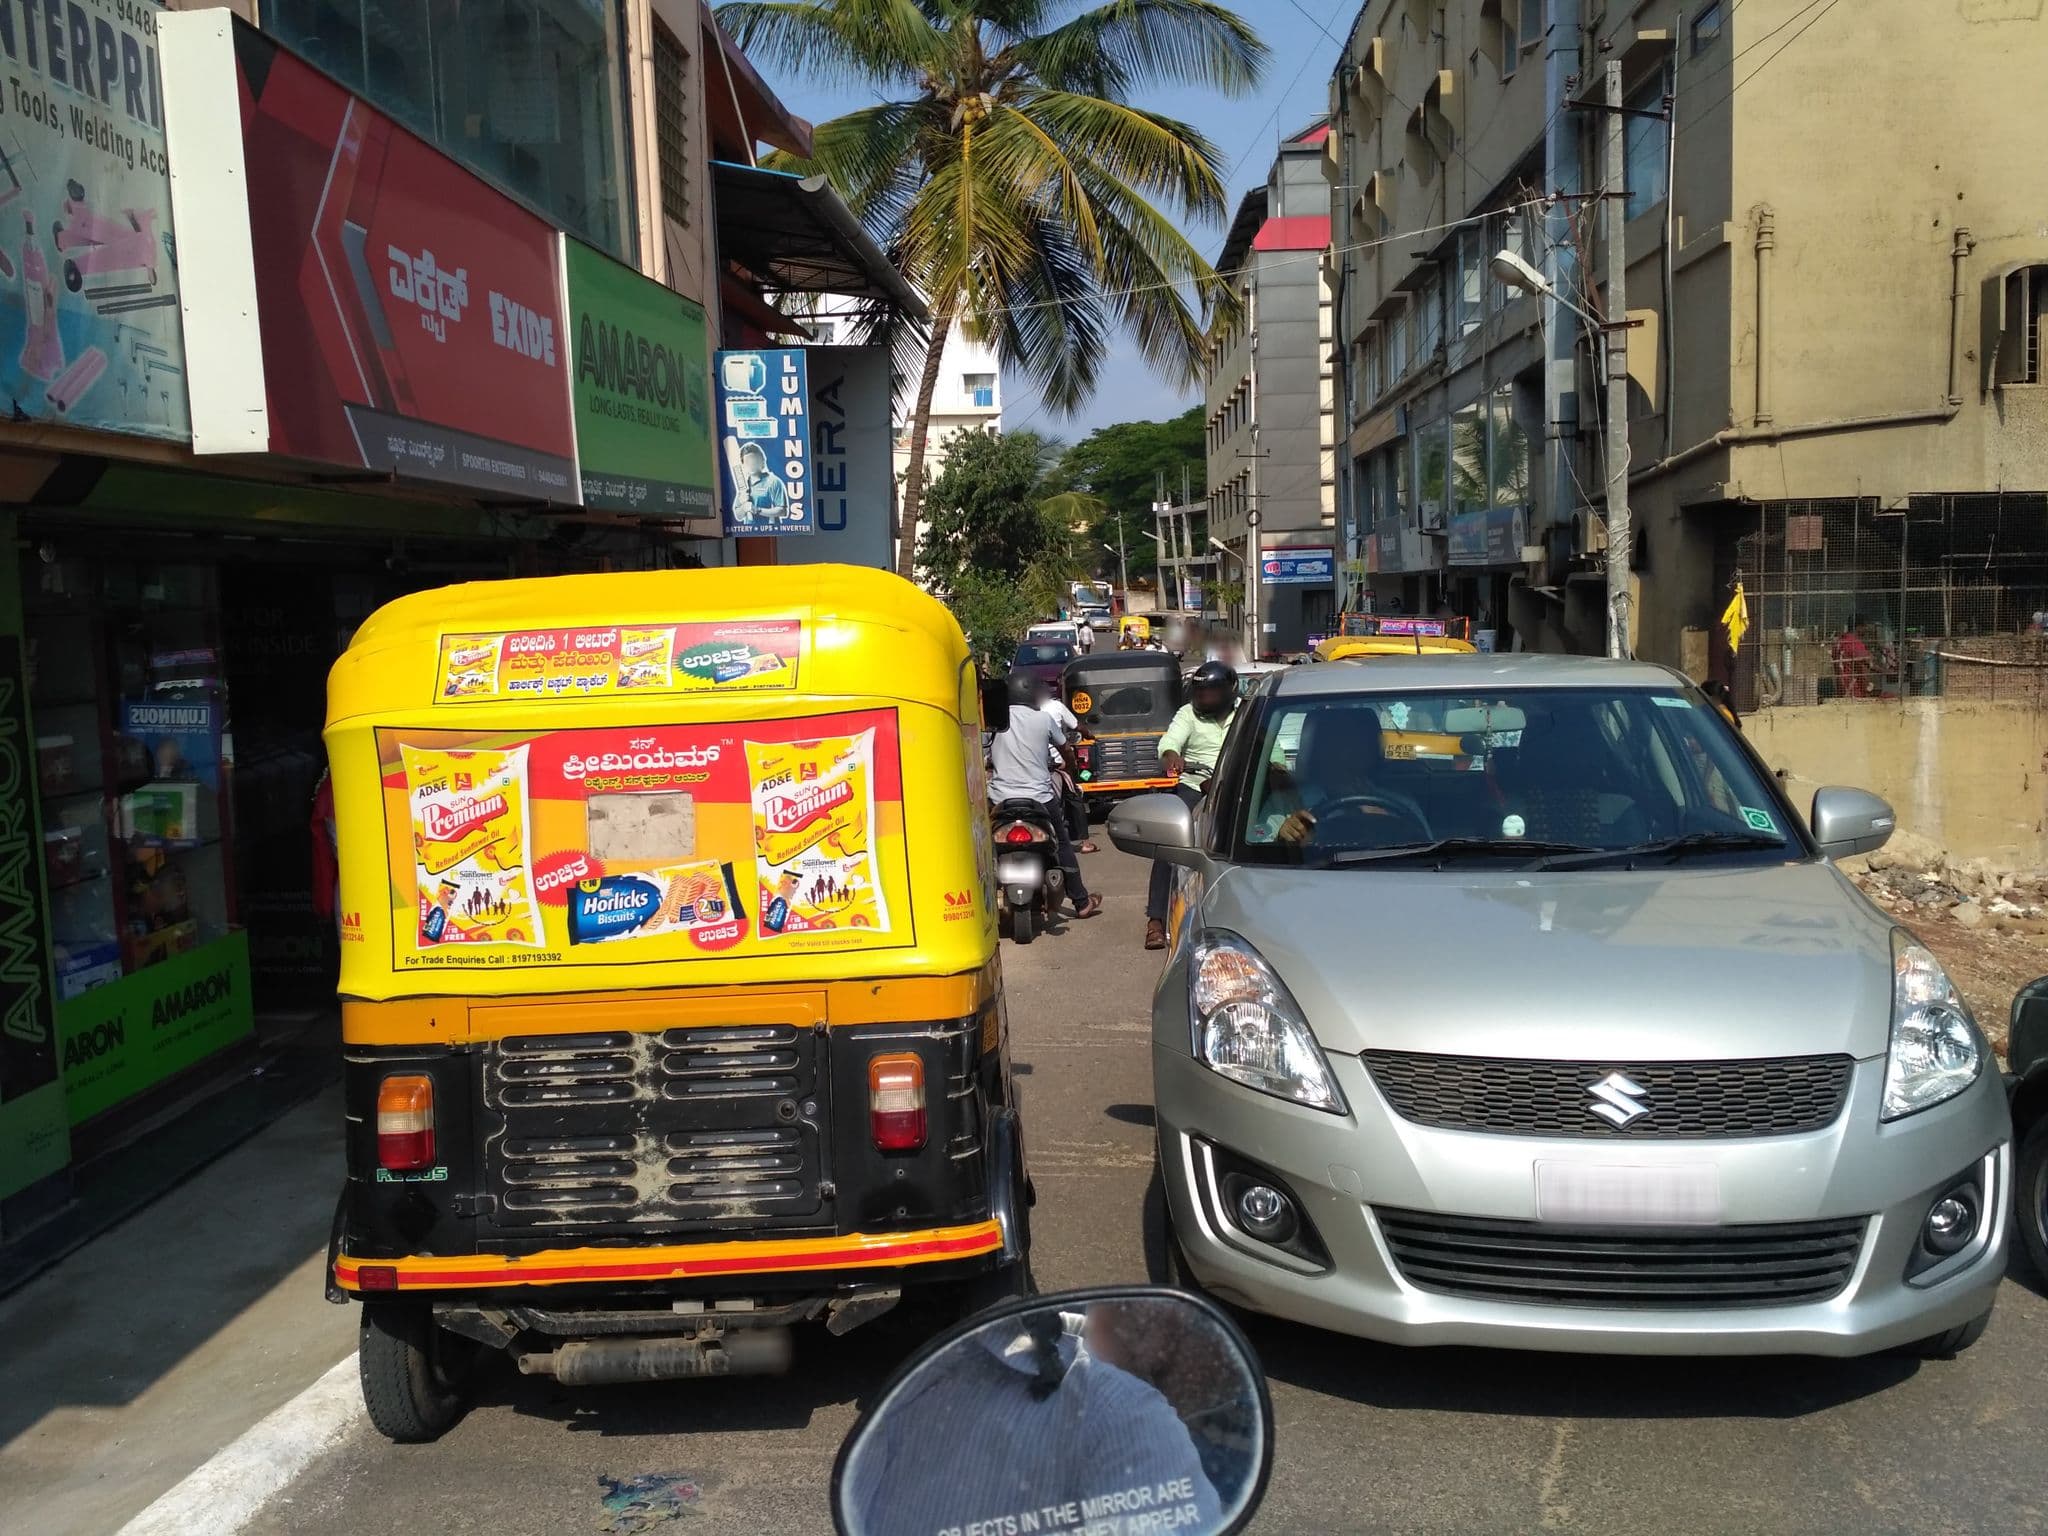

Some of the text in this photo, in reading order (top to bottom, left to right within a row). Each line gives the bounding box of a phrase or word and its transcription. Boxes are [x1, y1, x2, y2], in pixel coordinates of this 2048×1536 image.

[10, 76, 169, 178] Tools, Welding Acc
[488, 290, 556, 367] EXIDE
[579, 312, 686, 413] AMARON
[780, 354, 805, 521] LUMINOUS
[815, 375, 847, 531] CERA
[760, 524, 773, 533] UPS
[780, 524, 811, 533] INVERTER
[682, 645, 752, 669] ಉಚಿತ
[562, 745, 721, 780] ಪ್ರೀಮಿಯಮ್
[419, 780, 448, 799] AD&E
[761, 772, 793, 793] AD&E
[794, 786, 811, 800] SUN
[422, 795, 505, 839] Premium
[450, 795, 466, 809] SUN
[763, 780, 849, 831] Premium
[535, 855, 589, 892] ಉಚಿತ
[583, 891, 649, 915] Horlicks
[943, 888, 972, 906] SAI
[597, 910, 636, 925] Biscuits
[698, 923, 739, 942] ಉಚಿತ
[405, 956, 418, 965] For
[421, 955, 444, 964] Trade
[446, 954, 486, 966] Enquiries
[488, 954, 505, 964] Call
[511, 952, 562, 963] 8197193392
[152, 969, 231, 1030] AMARON
[1020, 1512, 1040, 1532] IN
[1042, 1502, 1081, 1527] THE
[1081, 1487, 1153, 1520] MIRROR
[1157, 1477, 1196, 1502] ARE
[1126, 1504, 1201, 1536] APPEAR
